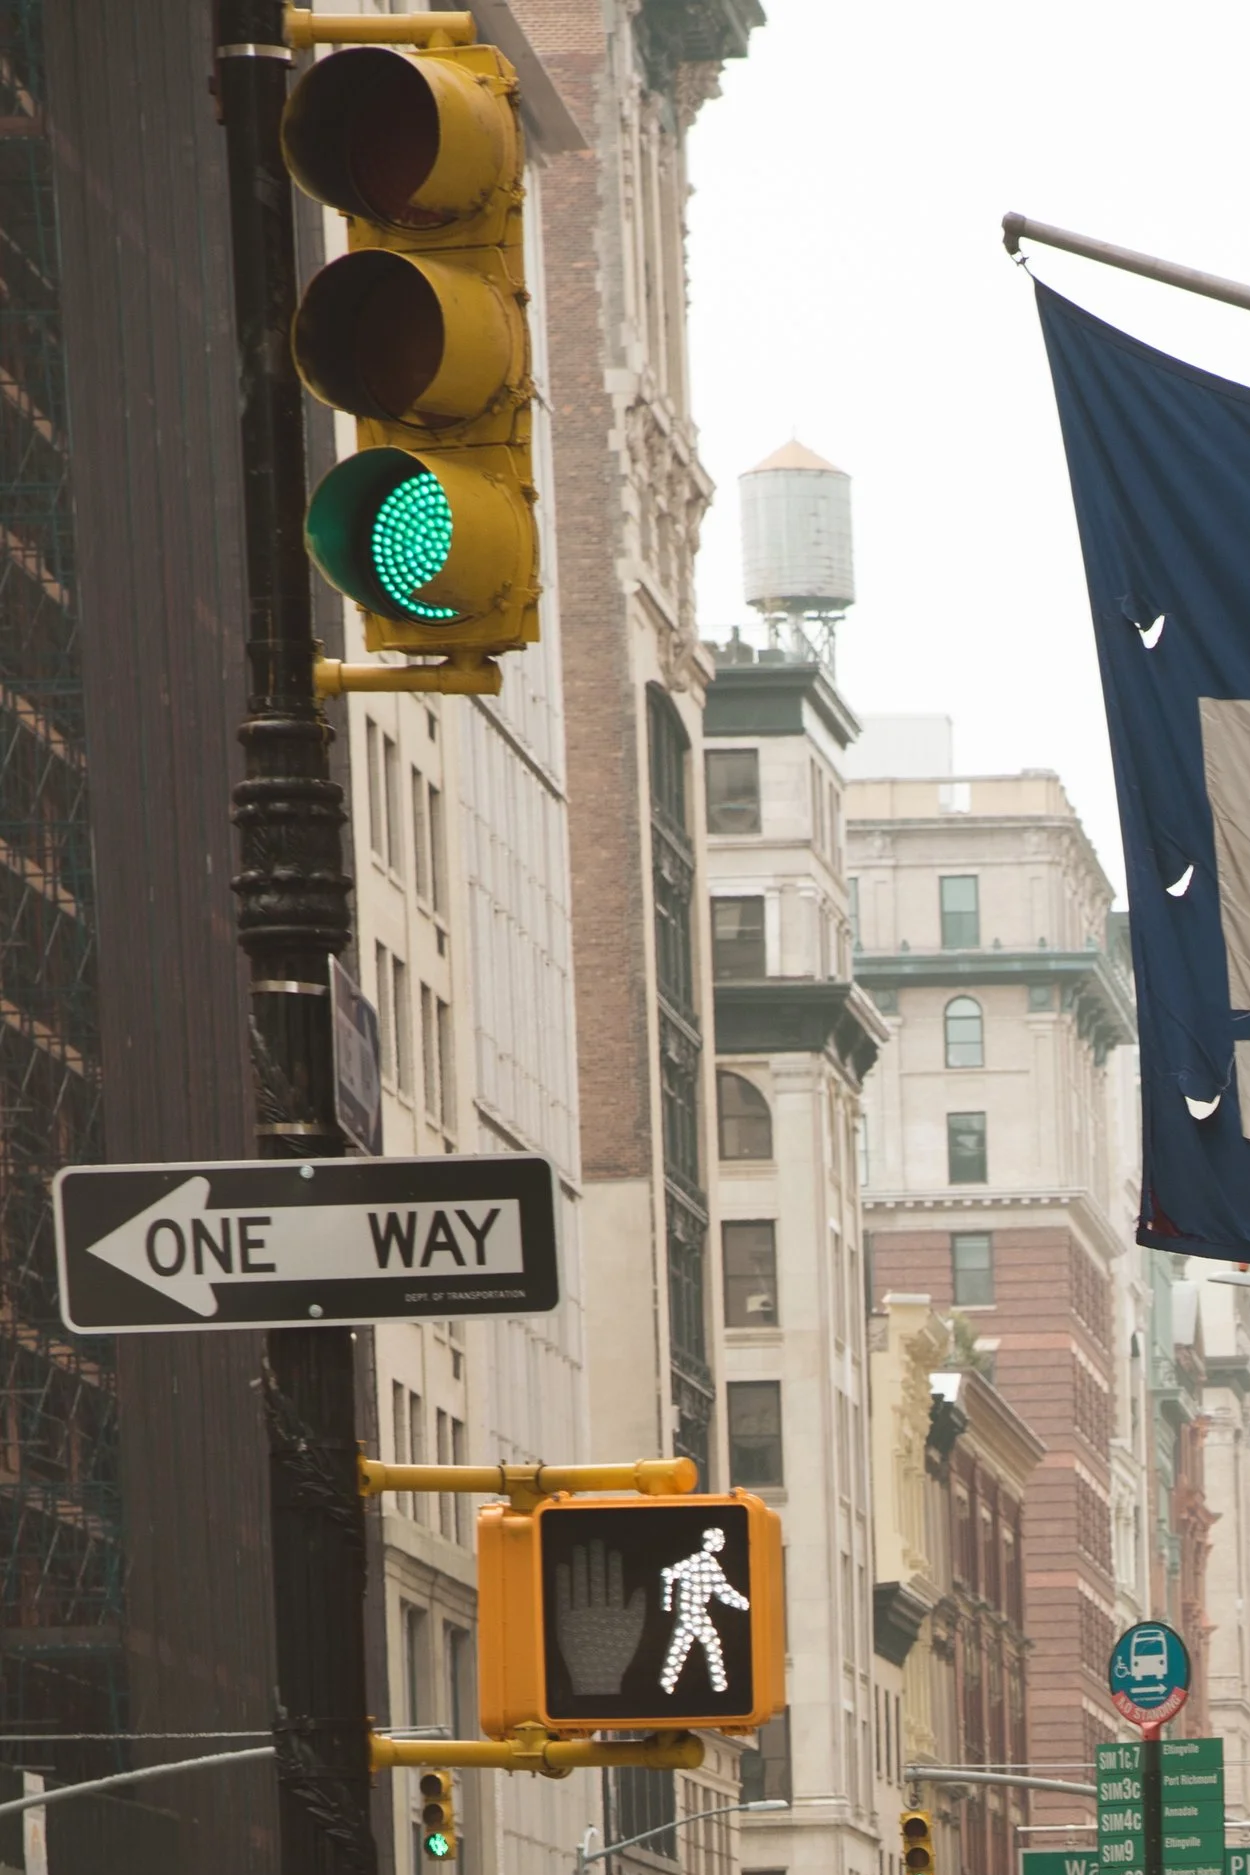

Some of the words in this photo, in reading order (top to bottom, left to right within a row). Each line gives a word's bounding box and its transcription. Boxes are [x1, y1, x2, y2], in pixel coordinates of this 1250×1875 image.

[145, 1216, 276, 1277] ONE
[367, 1207, 502, 1269] WAY
[432, 1292, 445, 1301] OF
[447, 1289, 527, 1300] TRANSPORTATION
[1133, 1693, 1182, 1720] STANDING
[1163, 1775, 1179, 1786] Port
[1181, 1773, 1217, 1785] Richmond
[1102, 1839, 1134, 1863] SIM9
